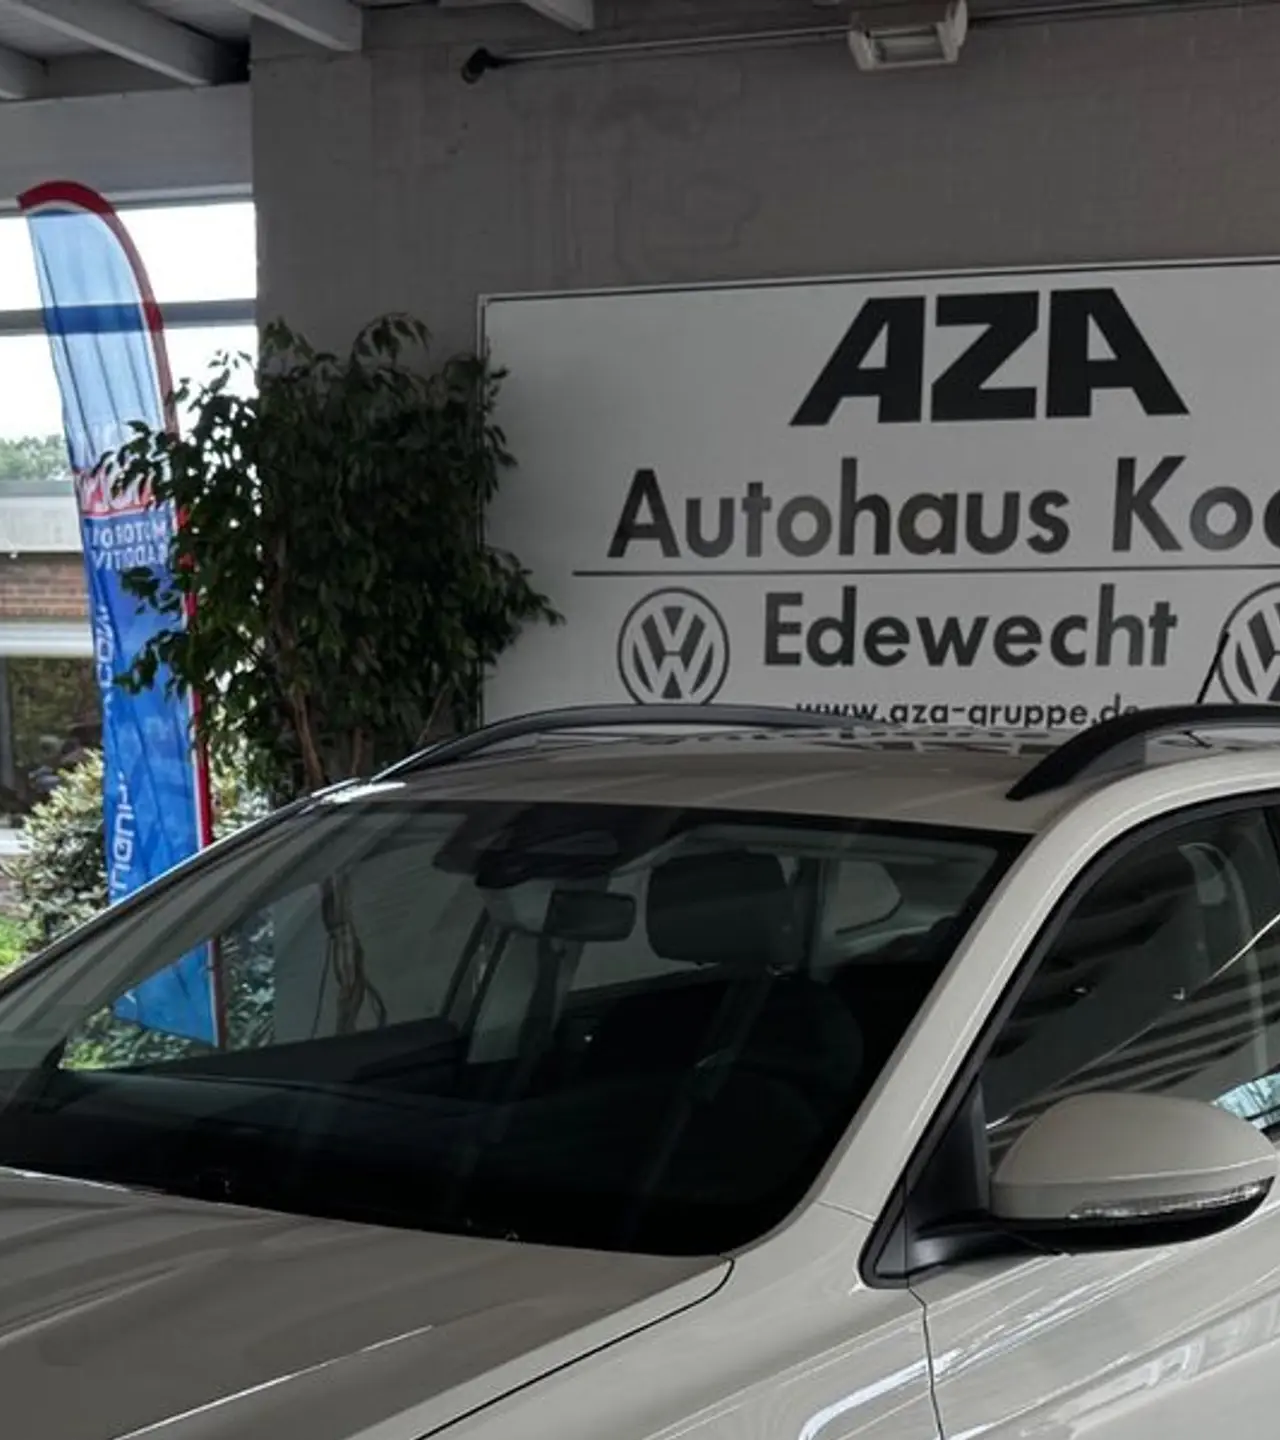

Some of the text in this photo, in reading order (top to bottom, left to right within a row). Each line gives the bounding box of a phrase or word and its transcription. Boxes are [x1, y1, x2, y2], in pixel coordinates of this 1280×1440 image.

[788, 288, 1190, 427] AZA
[606, 458, 1070, 559] Autohaus
[763, 584, 1177, 668] Edewecht
